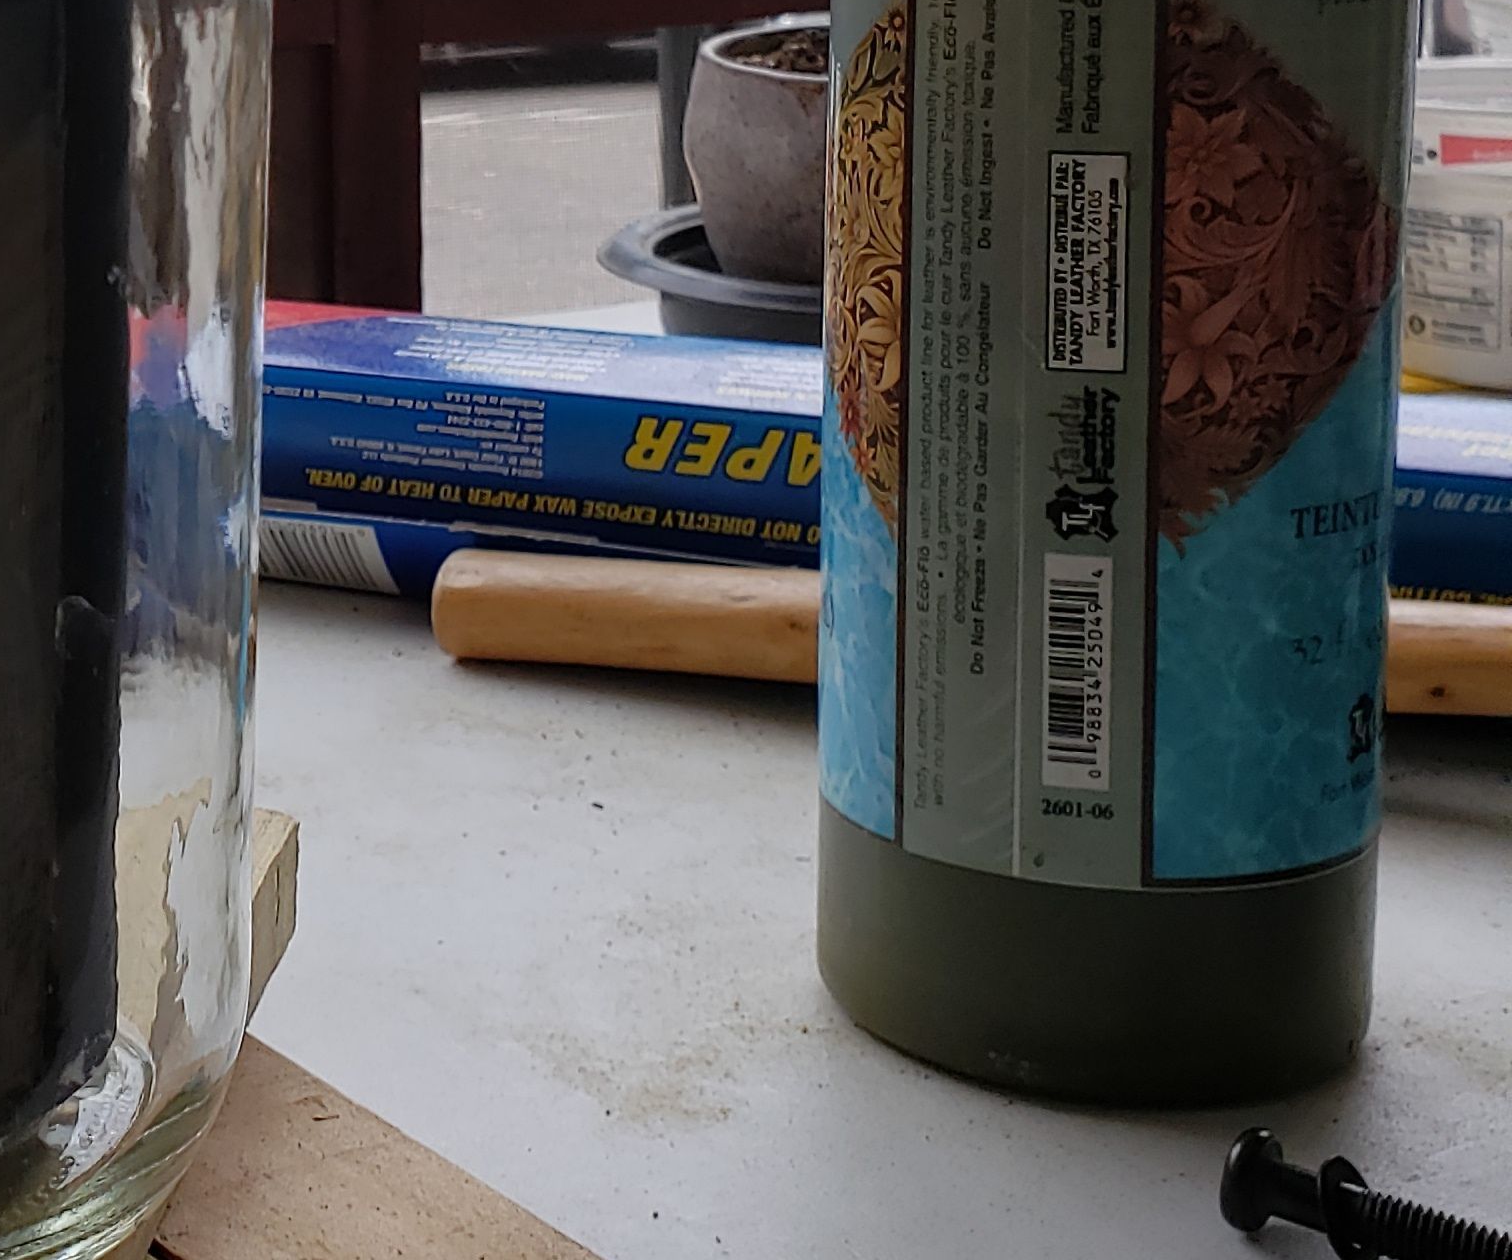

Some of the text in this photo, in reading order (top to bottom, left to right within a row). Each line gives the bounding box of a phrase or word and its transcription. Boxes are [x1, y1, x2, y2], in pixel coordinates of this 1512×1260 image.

[1086, 13, 1101, 47] aux
[981, 49, 995, 79] Pas
[1055, 8, 1076, 133] Manufactured
[941, 66, 958, 143] Factory's
[980, 86, 994, 108] Ne
[1081, 53, 1104, 133] Fabriqué
[924, 88, 940, 220] environmentally
[958, 111, 974, 186] émission
[940, 147, 954, 211] Leather
[977, 132, 996, 248] Do Not Ingest
[1054, 161, 1070, 189] PAR:
[939, 221, 955, 266] Tandy
[960, 193, 972, 255] aucune
[921, 245, 935, 302] leather
[959, 260, 971, 301] sans
[1068, 157, 1086, 365] TANDY LEATHER FACTORY
[1086, 188, 1104, 335] Fort Worth, TX 76105
[940, 273, 952, 304] cuir
[921, 308, 933, 329] for
[939, 310, 951, 324] le
[1052, 267, 1068, 360] DISTRIBUTED BY
[920, 335, 933, 364] line
[940, 330, 953, 367] pour
[920, 370, 934, 433] product
[938, 374, 953, 440] produits
[973, 282, 993, 540] Ne Pas Garder Au Congélateur
[1074, 385, 1098, 482] Leather
[1096, 387, 1120, 483] Factory
[919, 438, 931, 488] based
[937, 446, 949, 466] de
[304, 466, 355, 489] OVEN.
[358, 473, 382, 493] OF
[386, 476, 433, 499] HEAT
[439, 481, 461, 503] TO
[465, 485, 528, 510] PAPER
[533, 492, 575, 516] WAX
[581, 497, 656, 525] EXPOSE
[660, 506, 753, 536] DIRECTLY
[954, 511, 967, 527] et
[760, 519, 800, 542] NOT
[936, 540, 948, 560] La
[970, 557, 985, 674] Do Not Freeze
[1086, 601, 1103, 666] 25049
[915, 697, 927, 756] Leather
[1040, 797, 1114, 818] 2601-06
